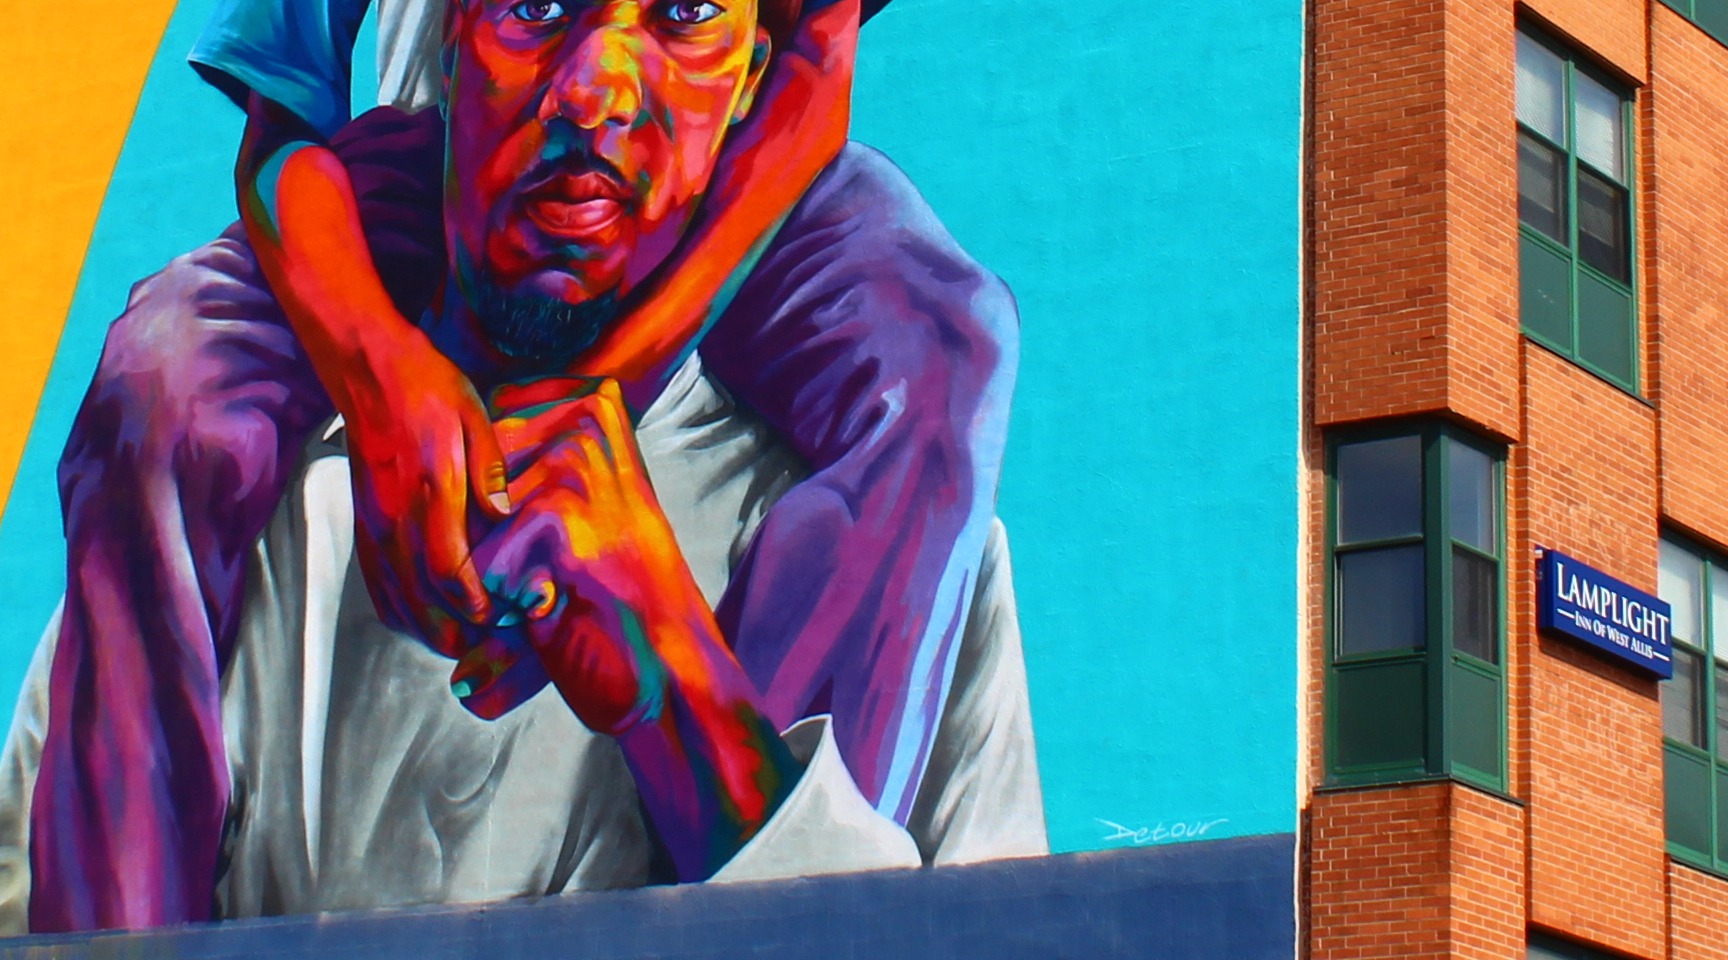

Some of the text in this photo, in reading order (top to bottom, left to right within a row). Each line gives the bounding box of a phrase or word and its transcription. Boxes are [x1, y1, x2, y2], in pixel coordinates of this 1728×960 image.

[1556, 561, 1669, 645] LAMPLIGHT
[1575, 610, 1654, 659] INN OF WEST ALLIS
